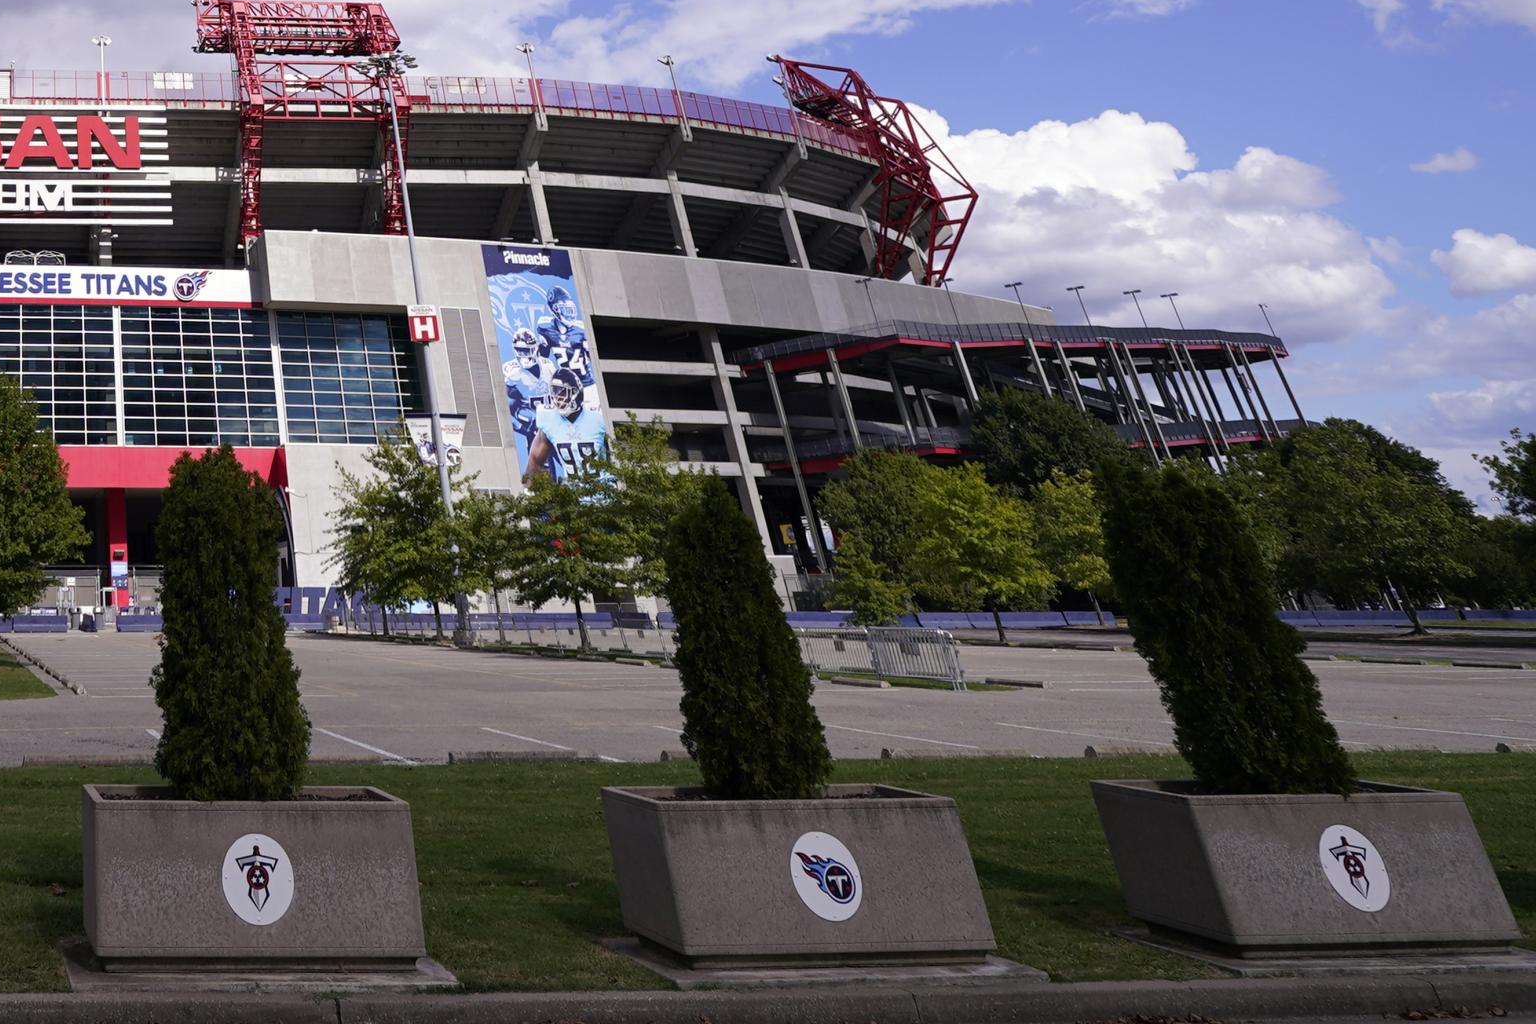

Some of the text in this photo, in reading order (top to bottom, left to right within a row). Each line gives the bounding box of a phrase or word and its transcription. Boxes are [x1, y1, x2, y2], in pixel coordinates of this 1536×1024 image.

[502, 250, 550, 266] Pinnacle
[81, 273, 167, 296] TITANS
[413, 317, 436, 339] H
[551, 347, 587, 375] 24
[557, 443, 601, 478] 98
